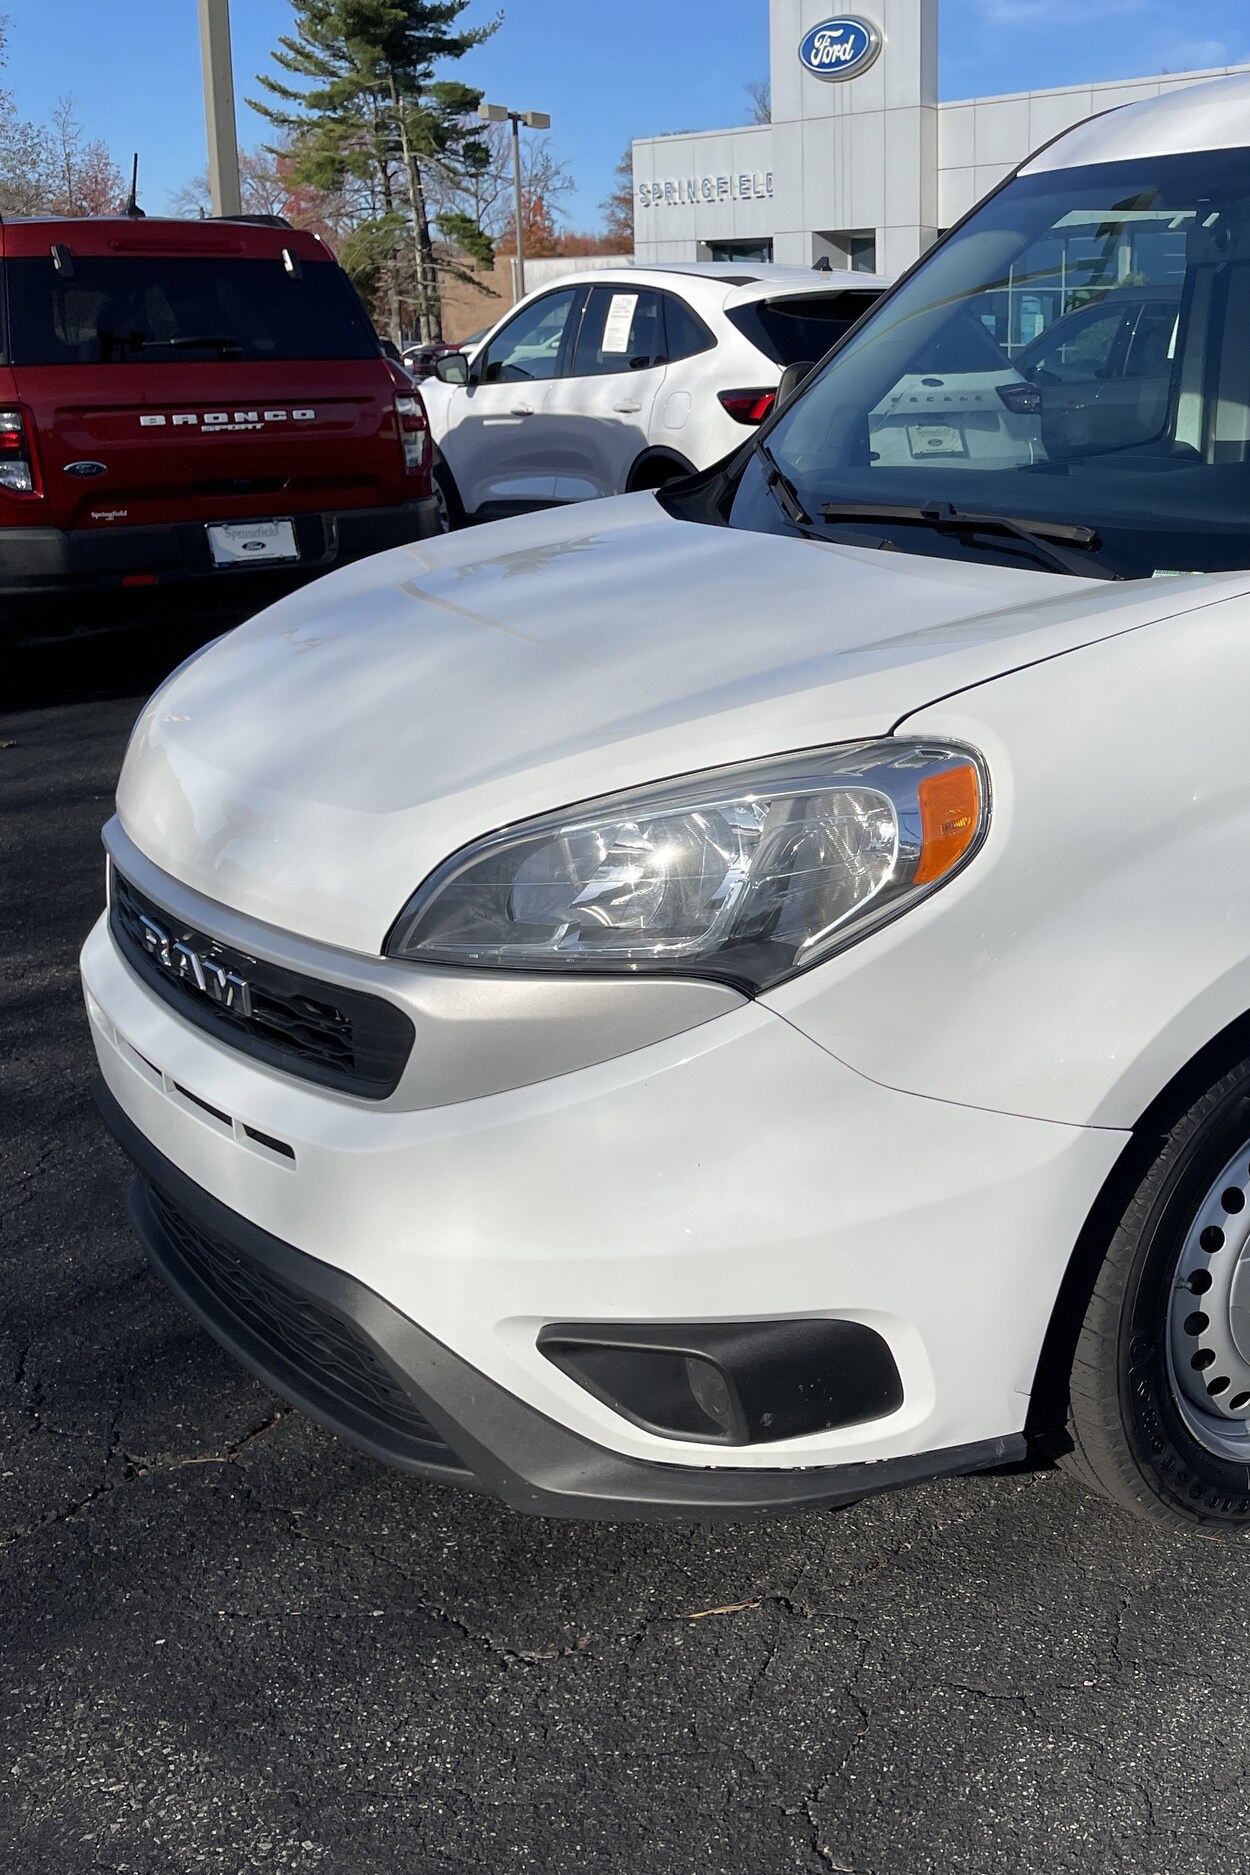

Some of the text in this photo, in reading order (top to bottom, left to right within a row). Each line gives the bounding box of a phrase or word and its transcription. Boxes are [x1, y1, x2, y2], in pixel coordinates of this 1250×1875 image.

[811, 29, 855, 66] Ford
[638, 172, 774, 205] SPRINGFIELD
[139, 409, 316, 426] BRONCO
[201, 422, 265, 433] SPORT
[140, 914, 252, 1018] RAM
